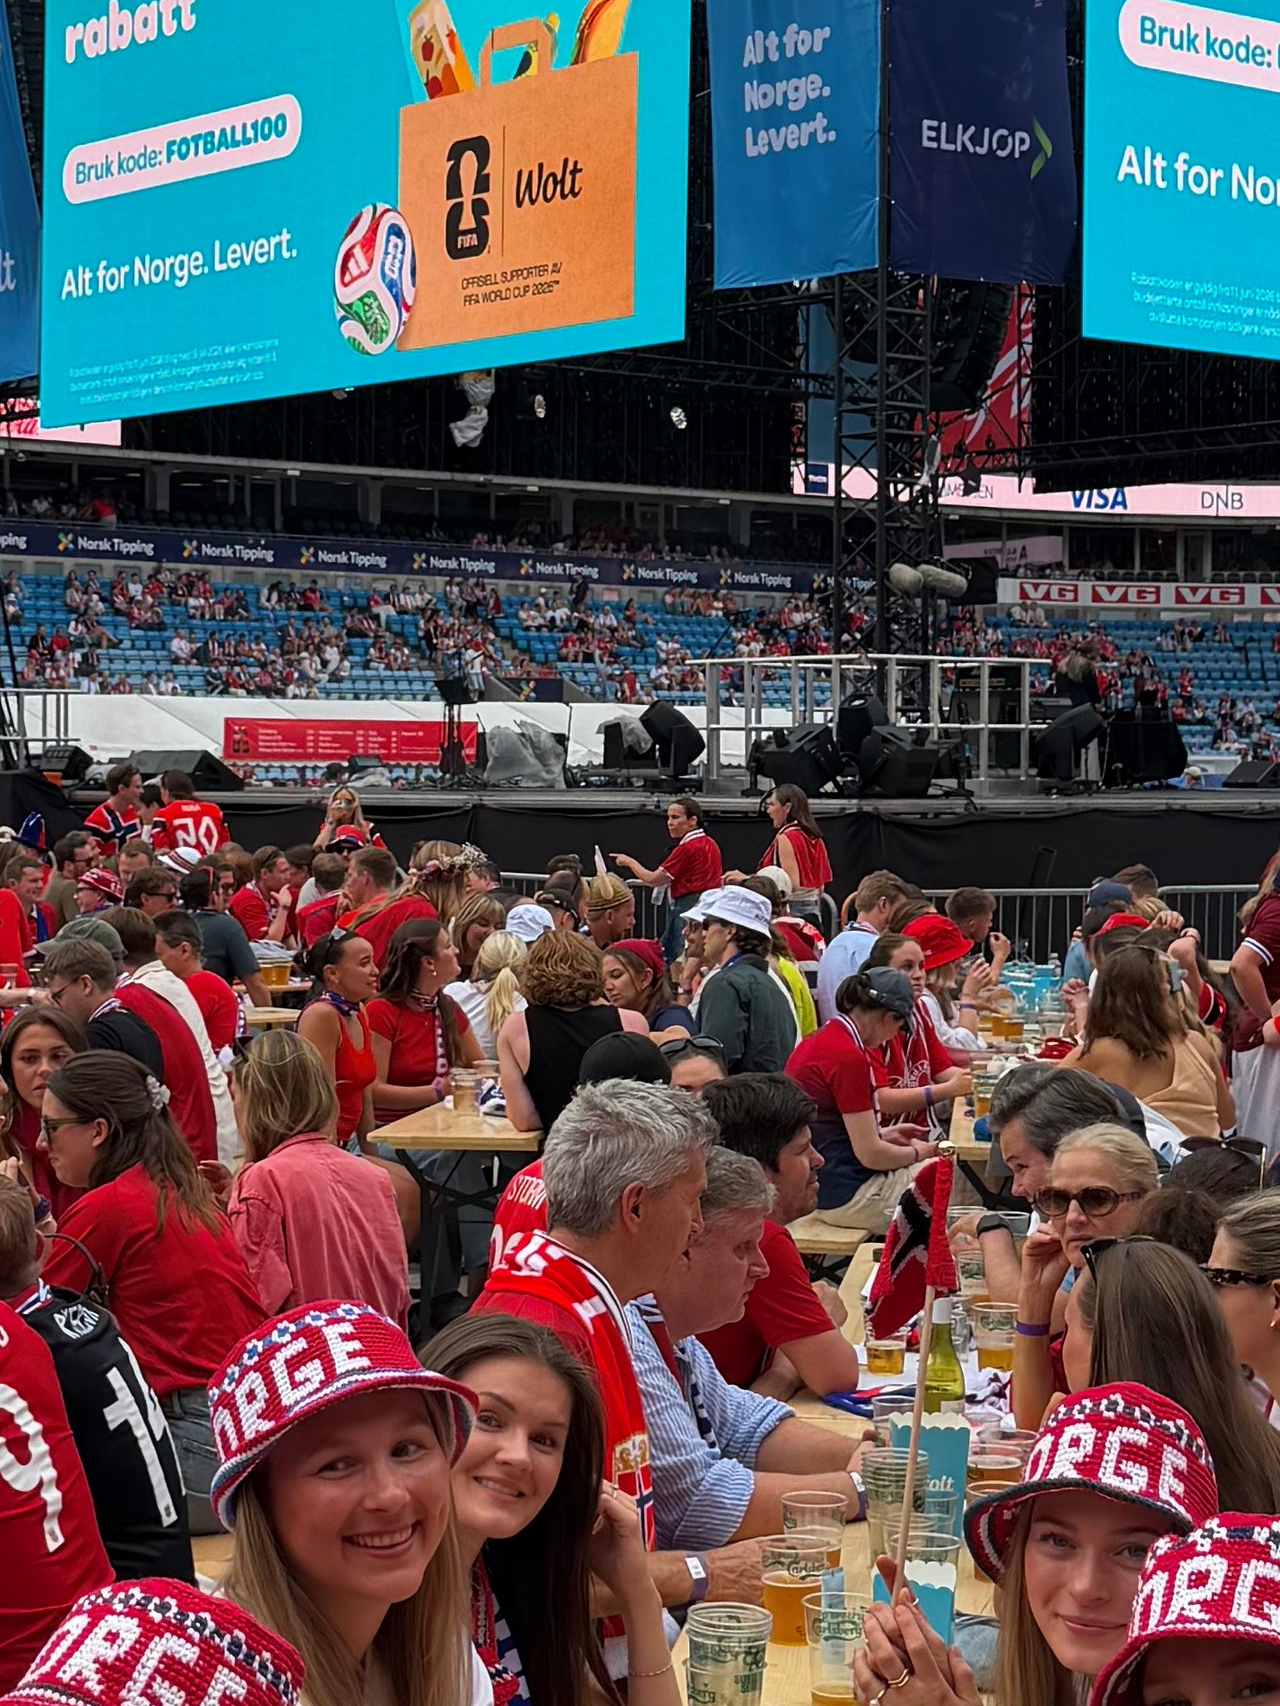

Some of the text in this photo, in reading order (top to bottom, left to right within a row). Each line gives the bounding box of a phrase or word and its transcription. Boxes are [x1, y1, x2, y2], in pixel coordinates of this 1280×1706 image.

[743, 23, 831, 69] Alt for
[1139, 16, 1200, 60] Bruk
[1204, 33, 1273, 70] kode:
[744, 70, 831, 113] Norge.
[75, 112, 288, 185] Bruk kode: FOTBALL100
[745, 112, 837, 158] Levert.
[515, 156, 583, 209] Wolt
[1118, 145, 1167, 190] Alt
[1174, 152, 1223, 197] for
[457, 234, 478, 249] FIFA
[61, 227, 298, 301] Alt for Norge. Levert.
[482, 287, 511, 303] WORLD
[1070, 487, 1128, 511] VISA
[1201, 484, 1244, 516] DNB
[1023, 583, 1077, 600] VG
[1093, 586, 1159, 603] VG
[1176, 587, 1245, 604] VG
[173, 816, 218, 854] 20
